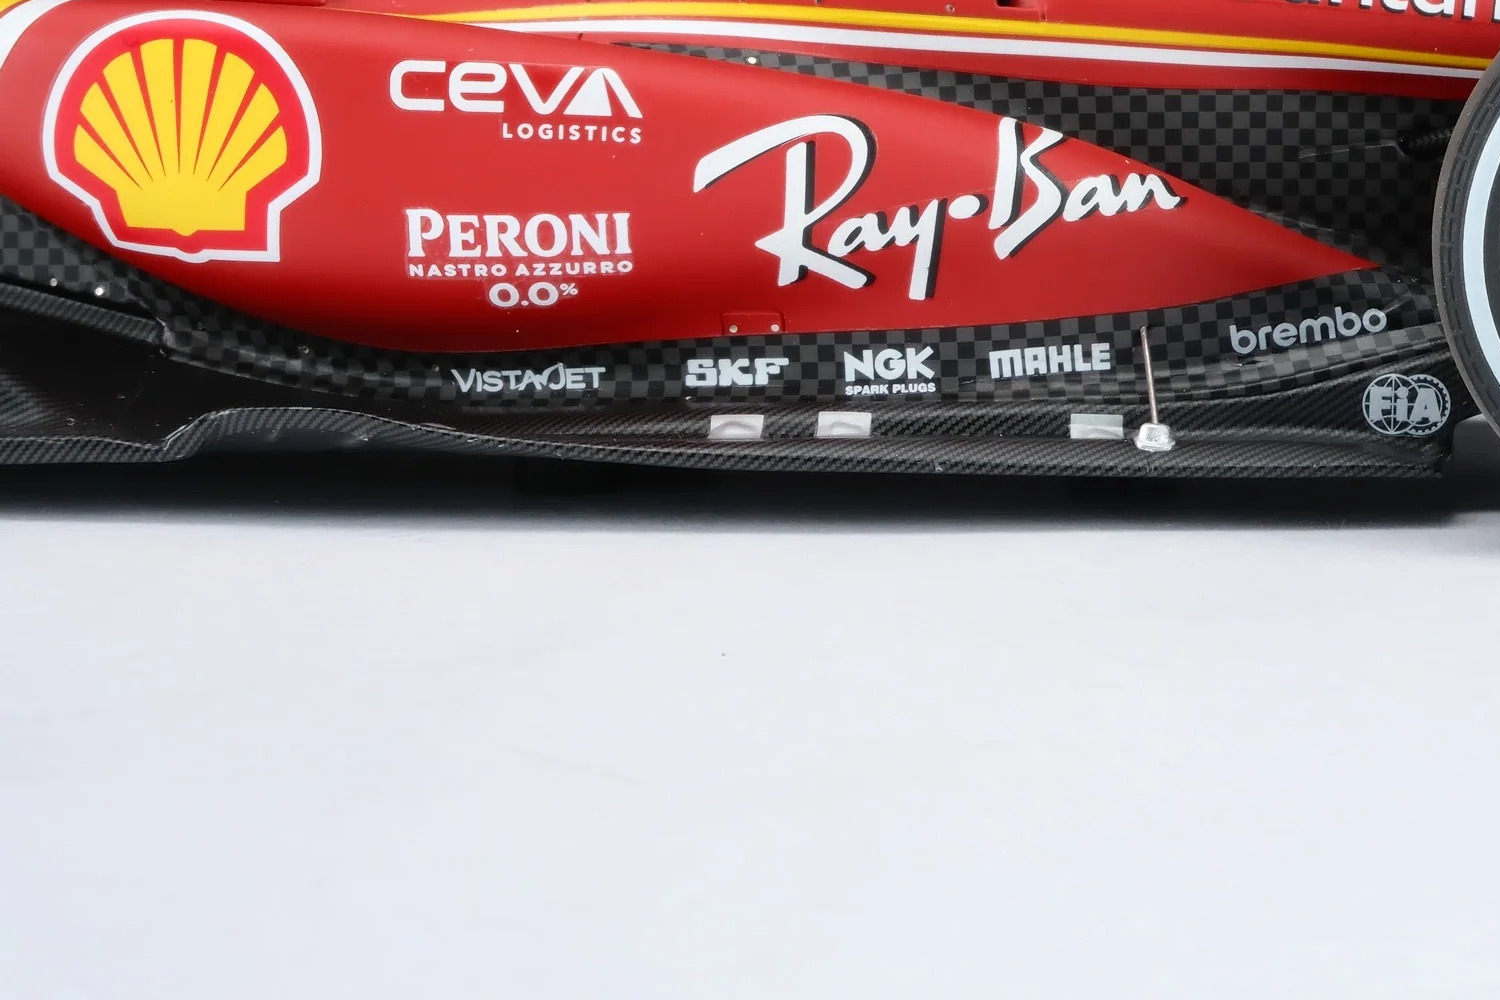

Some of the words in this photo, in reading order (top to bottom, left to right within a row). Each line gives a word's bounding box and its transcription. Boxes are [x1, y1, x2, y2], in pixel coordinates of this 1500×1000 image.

[502, 123, 643, 144] LOGISTICS
[405, 209, 632, 258] PERONI
[409, 264, 507, 277] NASTRO
[515, 260, 633, 276] AZZURRO
[1229, 306, 1387, 355] brembo
[686, 357, 790, 387] SKF
[843, 346, 935, 382] NGK
[989, 342, 1111, 379] MAHLE
[845, 384, 889, 396] SPARK
[892, 382, 936, 394] PLUGS
